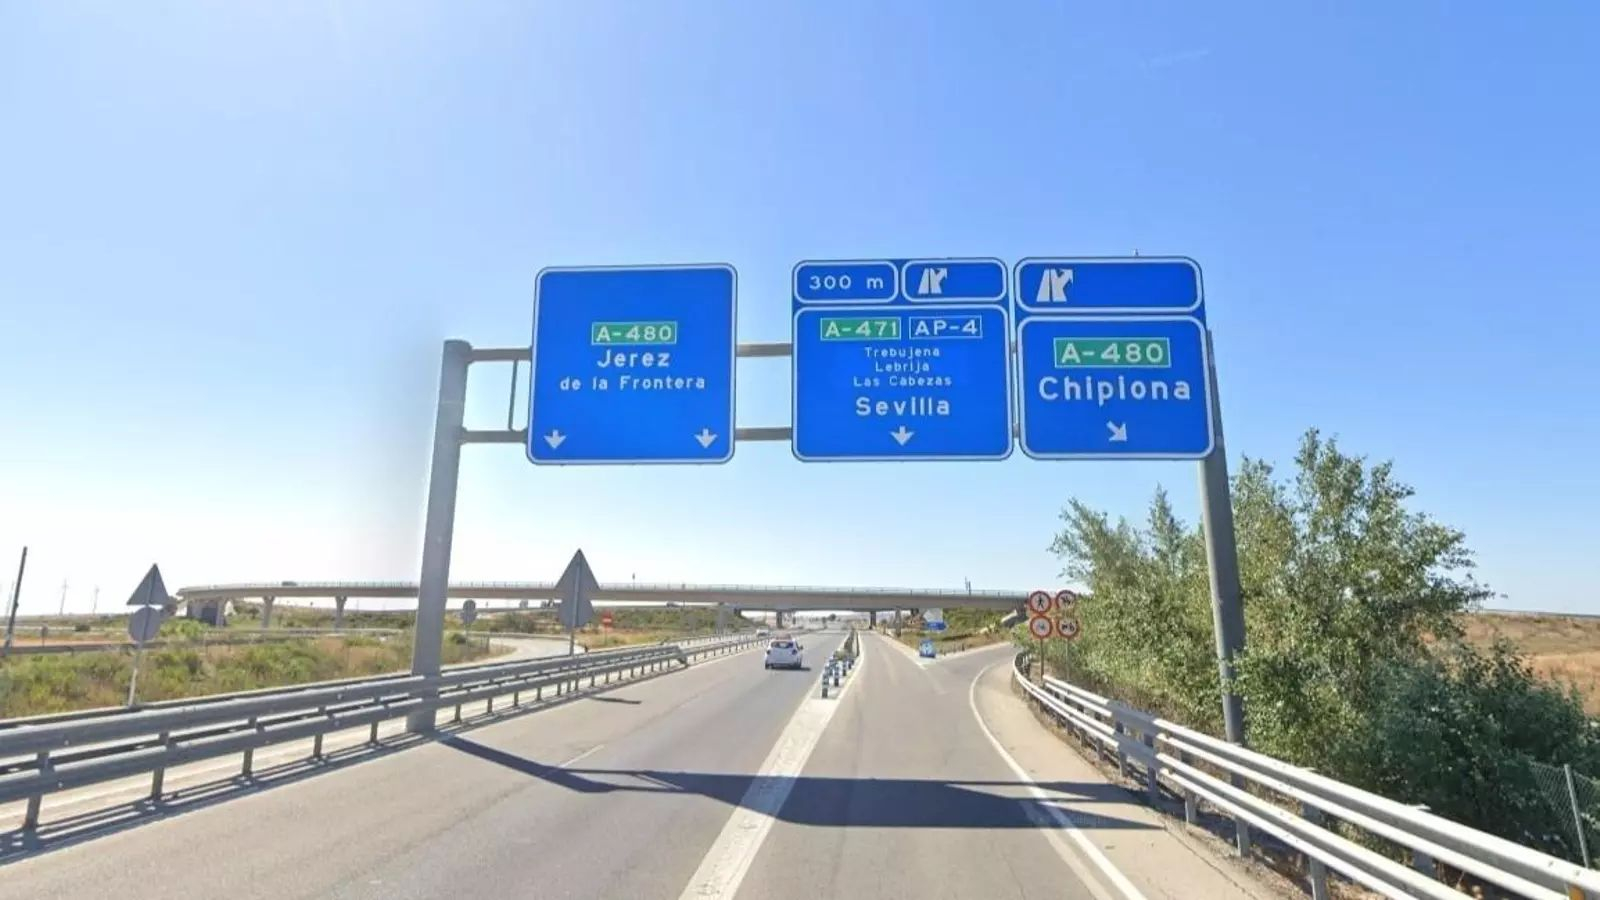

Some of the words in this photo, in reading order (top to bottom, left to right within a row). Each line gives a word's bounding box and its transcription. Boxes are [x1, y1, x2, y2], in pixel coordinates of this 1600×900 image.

[809, 275, 852, 290] 300
[867, 277, 883, 289] m
[596, 325, 672, 342] A-480
[826, 322, 897, 337] A-471
[915, 319, 978, 335] AP-4
[597, 350, 670, 368] Jerez
[864, 347, 940, 359] Trebujena
[1061, 343, 1163, 363] A-480
[875, 361, 929, 373] Lebrija
[560, 377, 581, 391] de
[592, 377, 608, 390] la
[620, 375, 705, 390] Frontera
[853, 376, 880, 387] Las
[889, 375, 952, 386] Cabezas
[1039, 375, 1190, 407] Chipiona
[855, 396, 950, 416] Sevilla
